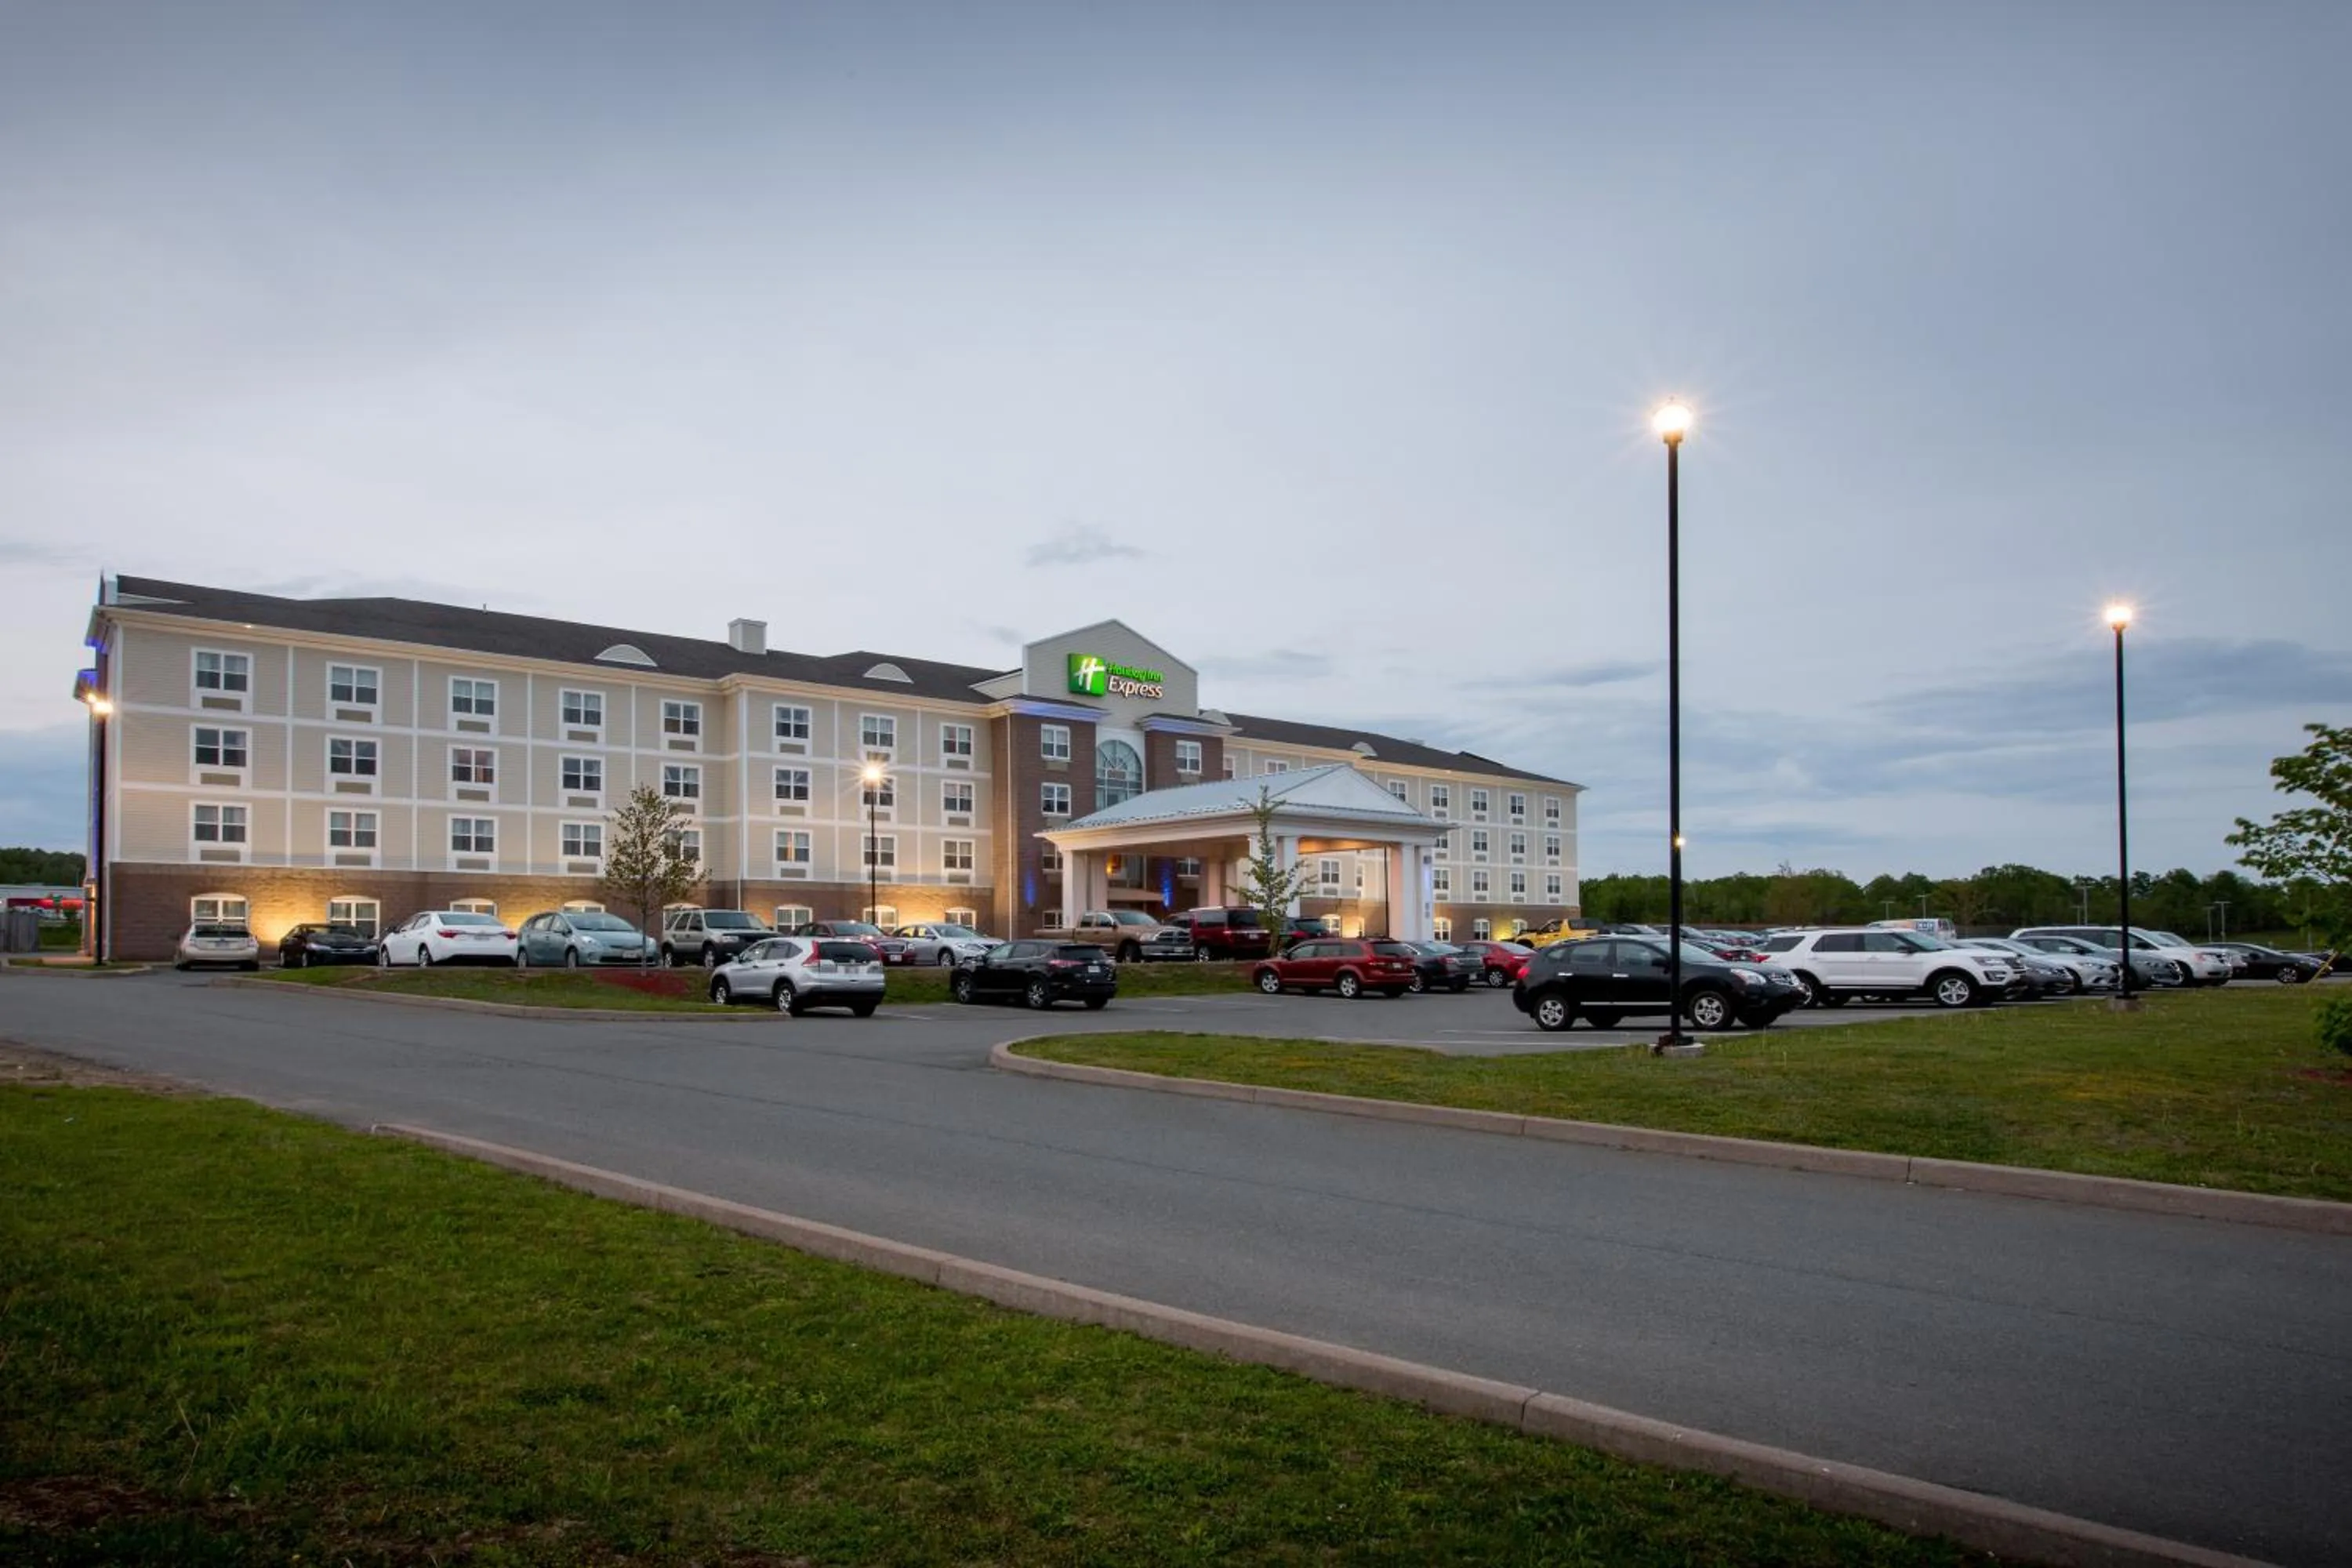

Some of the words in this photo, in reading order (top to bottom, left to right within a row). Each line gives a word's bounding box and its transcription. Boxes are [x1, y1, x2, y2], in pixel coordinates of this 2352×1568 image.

[1107, 663, 1146, 681] Holiday
[1147, 670, 1163, 682] Inn
[1108, 675, 1163, 698] Express
